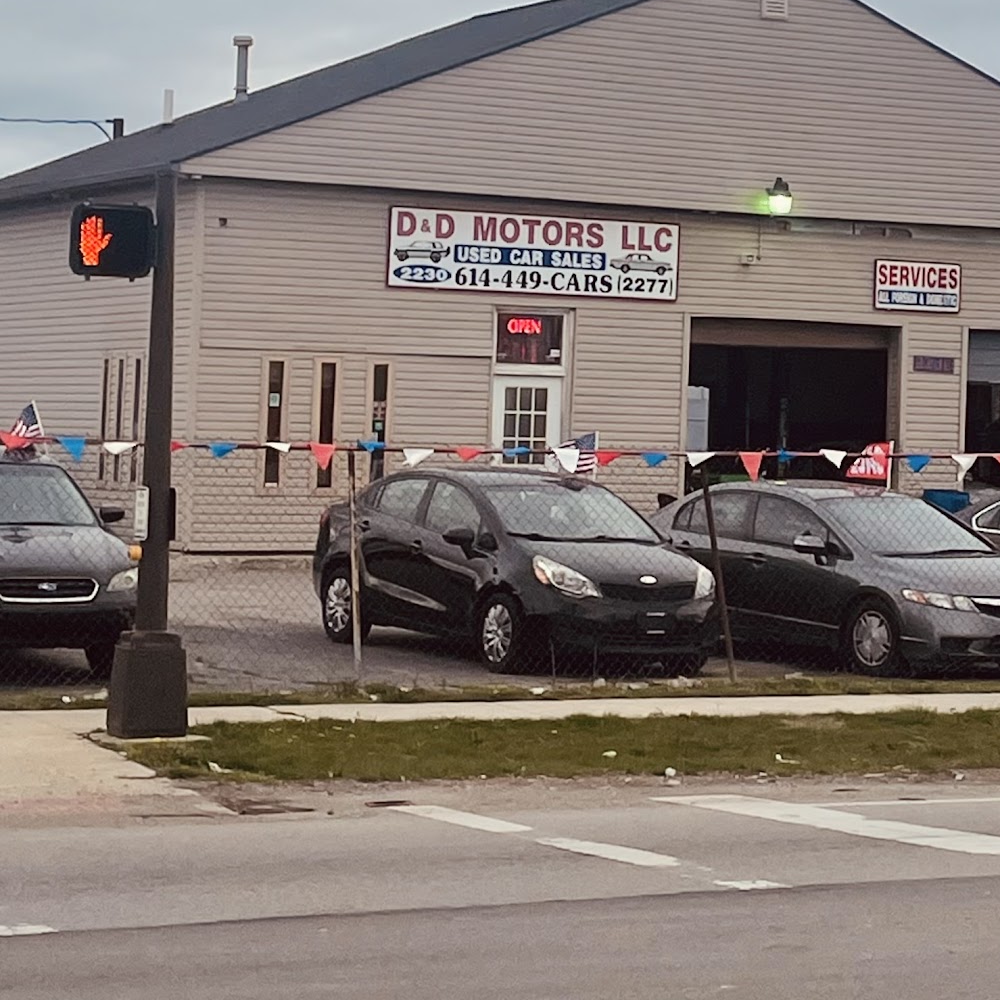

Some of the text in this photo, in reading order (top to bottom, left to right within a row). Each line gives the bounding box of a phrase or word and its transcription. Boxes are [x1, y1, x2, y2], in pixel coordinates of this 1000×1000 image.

[397, 211, 673, 252] D&D MOTORS LLC
[457, 246, 603, 269] USED CAR SALES
[400, 266, 449, 281] 2230
[455, 267, 673, 297] 614-449-CARS (2277)
[878, 264, 958, 289] SERVICES
[507, 317, 542, 334] OPEN
